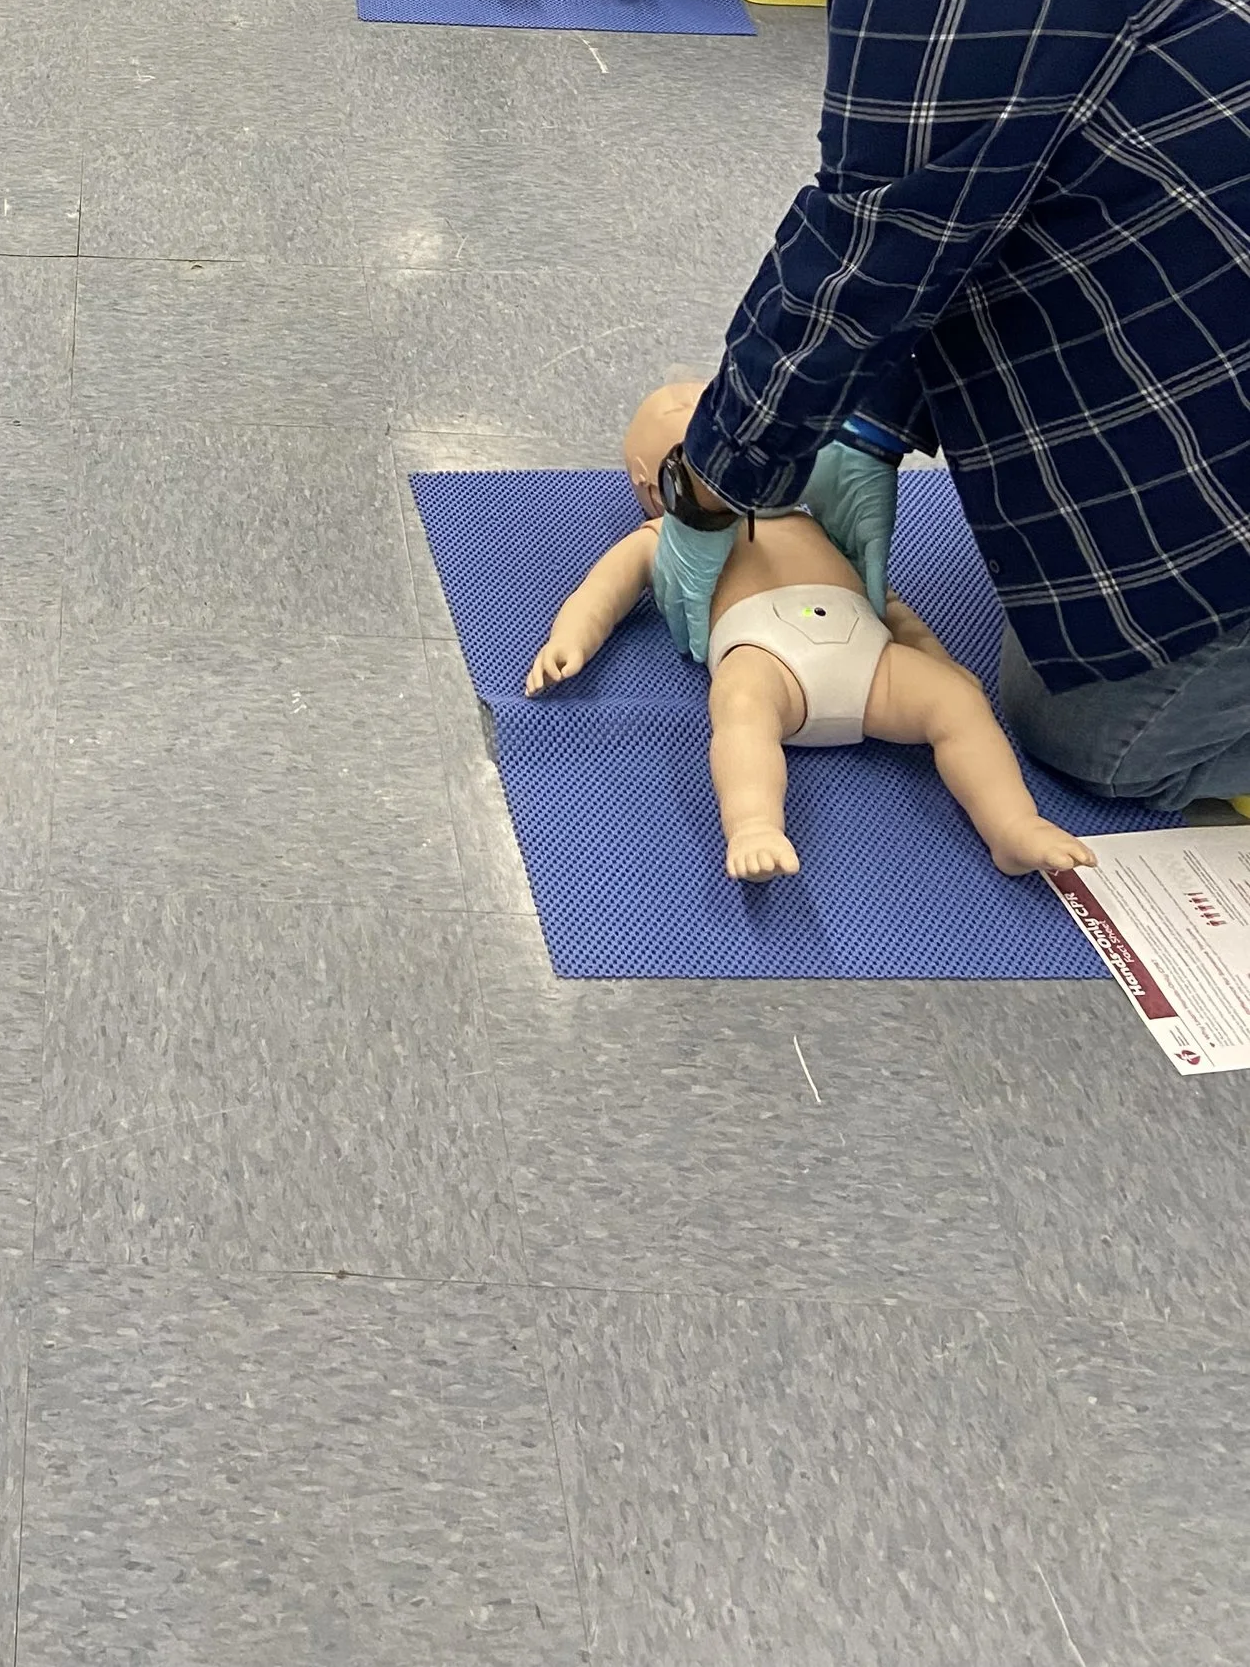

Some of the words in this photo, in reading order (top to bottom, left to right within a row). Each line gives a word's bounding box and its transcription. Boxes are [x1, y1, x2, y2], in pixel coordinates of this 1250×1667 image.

[1063, 892, 1089, 918] CPR
[1099, 919, 1121, 944] Sheet
[1084, 918, 1146, 996] Hands-Only
[1116, 944, 1135, 963] Fact
